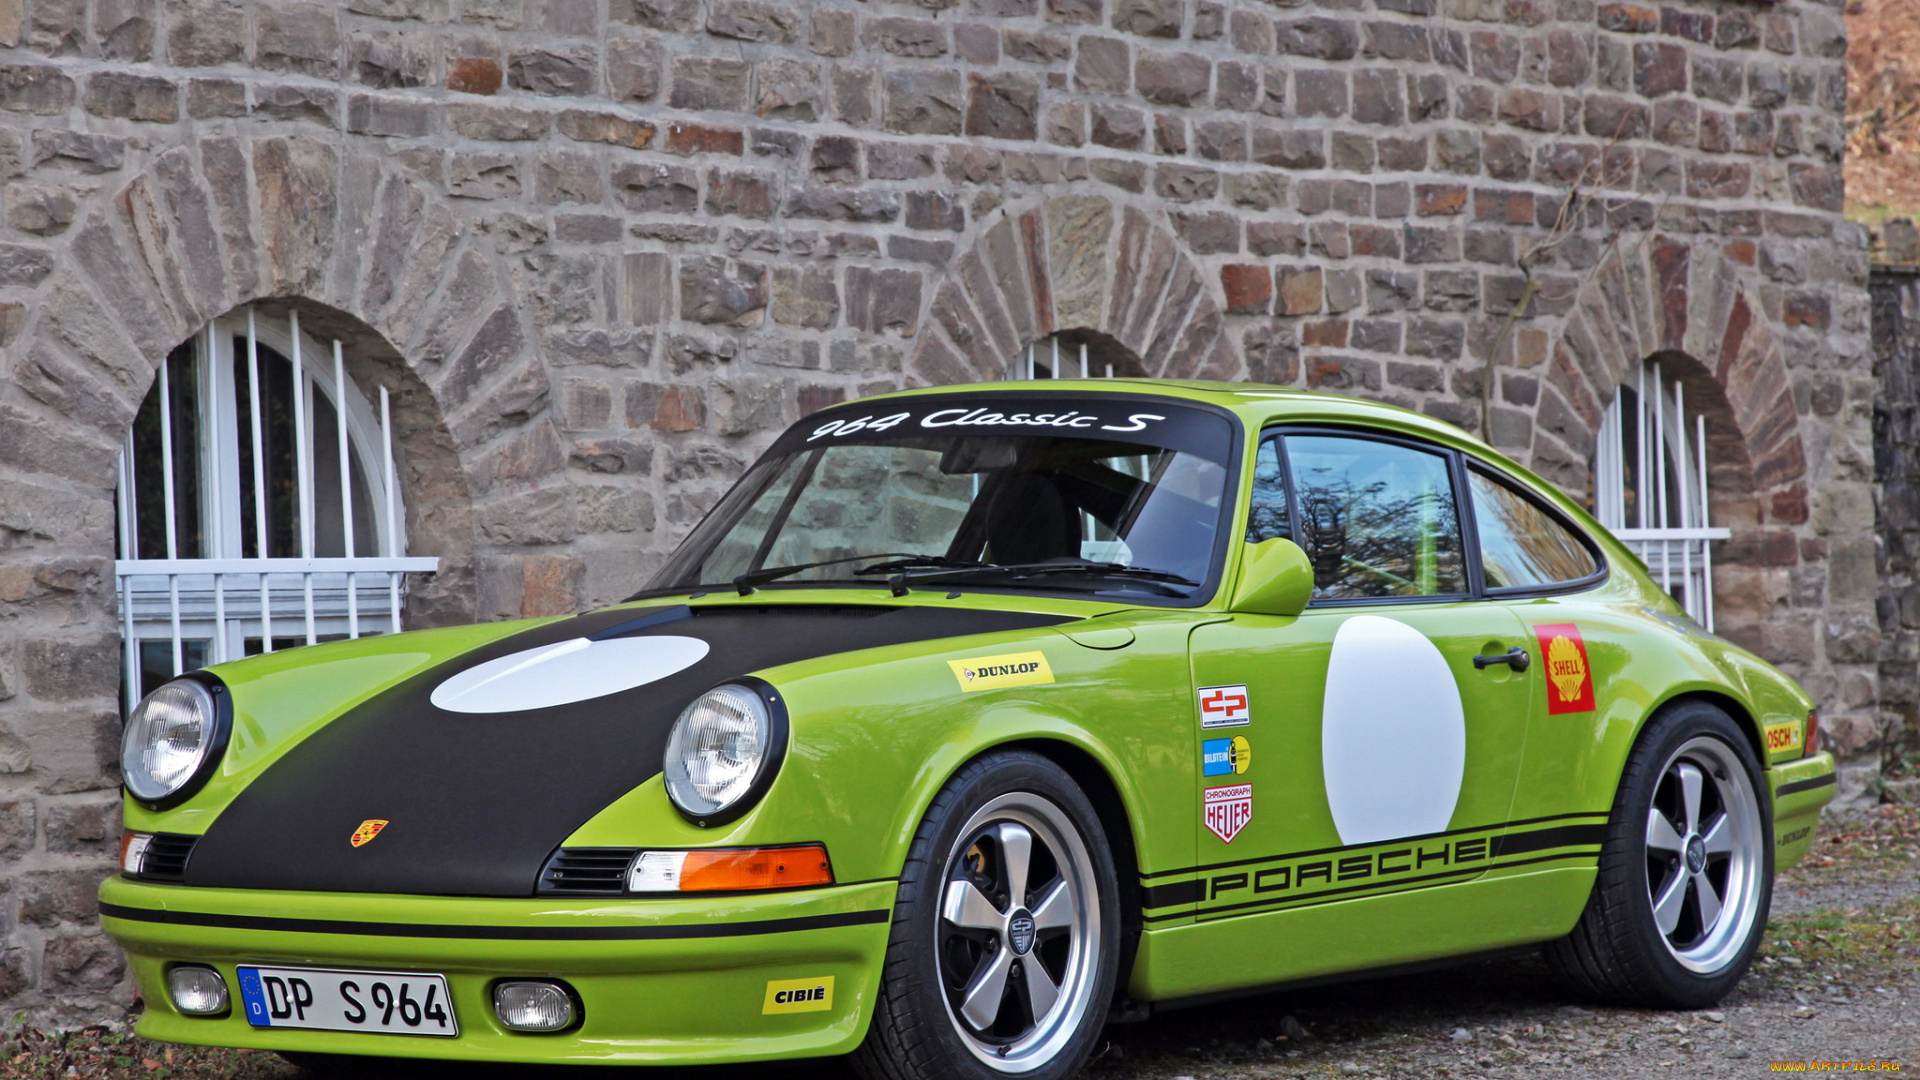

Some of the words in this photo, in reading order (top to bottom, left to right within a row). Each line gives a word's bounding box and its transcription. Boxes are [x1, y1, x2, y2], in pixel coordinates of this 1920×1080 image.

[806, 412, 911, 442] 964
[920, 407, 1098, 429] Classic
[1101, 413, 1166, 432] S
[977, 662, 1039, 678] DUNLOP
[1554, 660, 1581, 676] SHELL
[1204, 752, 1229, 764] BILSTEIN
[1206, 787, 1251, 800] CHRONOGRAPH
[1207, 802, 1250, 839] HEUER
[1210, 837, 1487, 900] PORSCHE
[262, 976, 313, 1021] DP
[774, 985, 825, 1004] CIBIÉ
[252, 1002, 262, 1015] D
